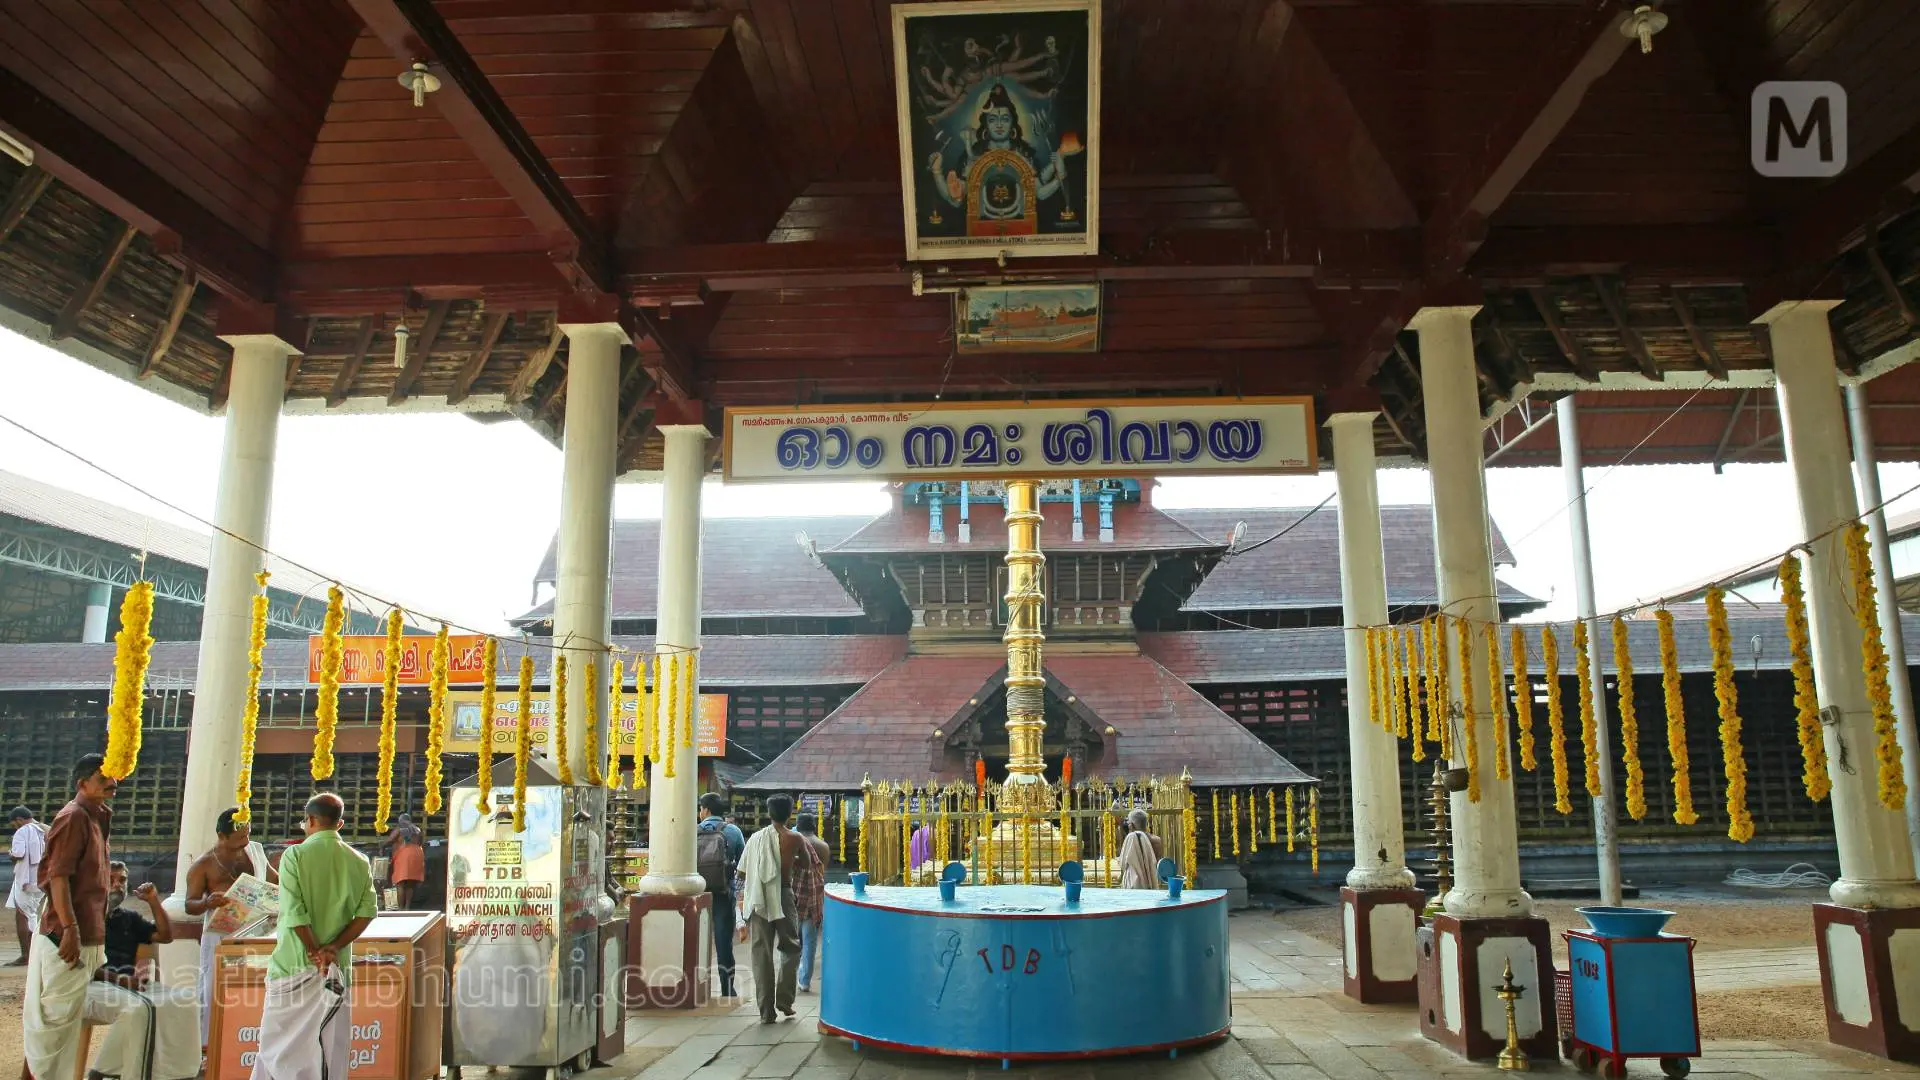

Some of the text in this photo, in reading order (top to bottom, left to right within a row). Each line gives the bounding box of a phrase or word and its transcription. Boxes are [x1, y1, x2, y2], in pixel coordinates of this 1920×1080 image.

[776, 426, 884, 470] ഓം
[1040, 407, 1263, 465] ശിവായ
[454, 885, 513, 899] അന്നദാന
[454, 903, 553, 916] ANNADANA VANCHI
